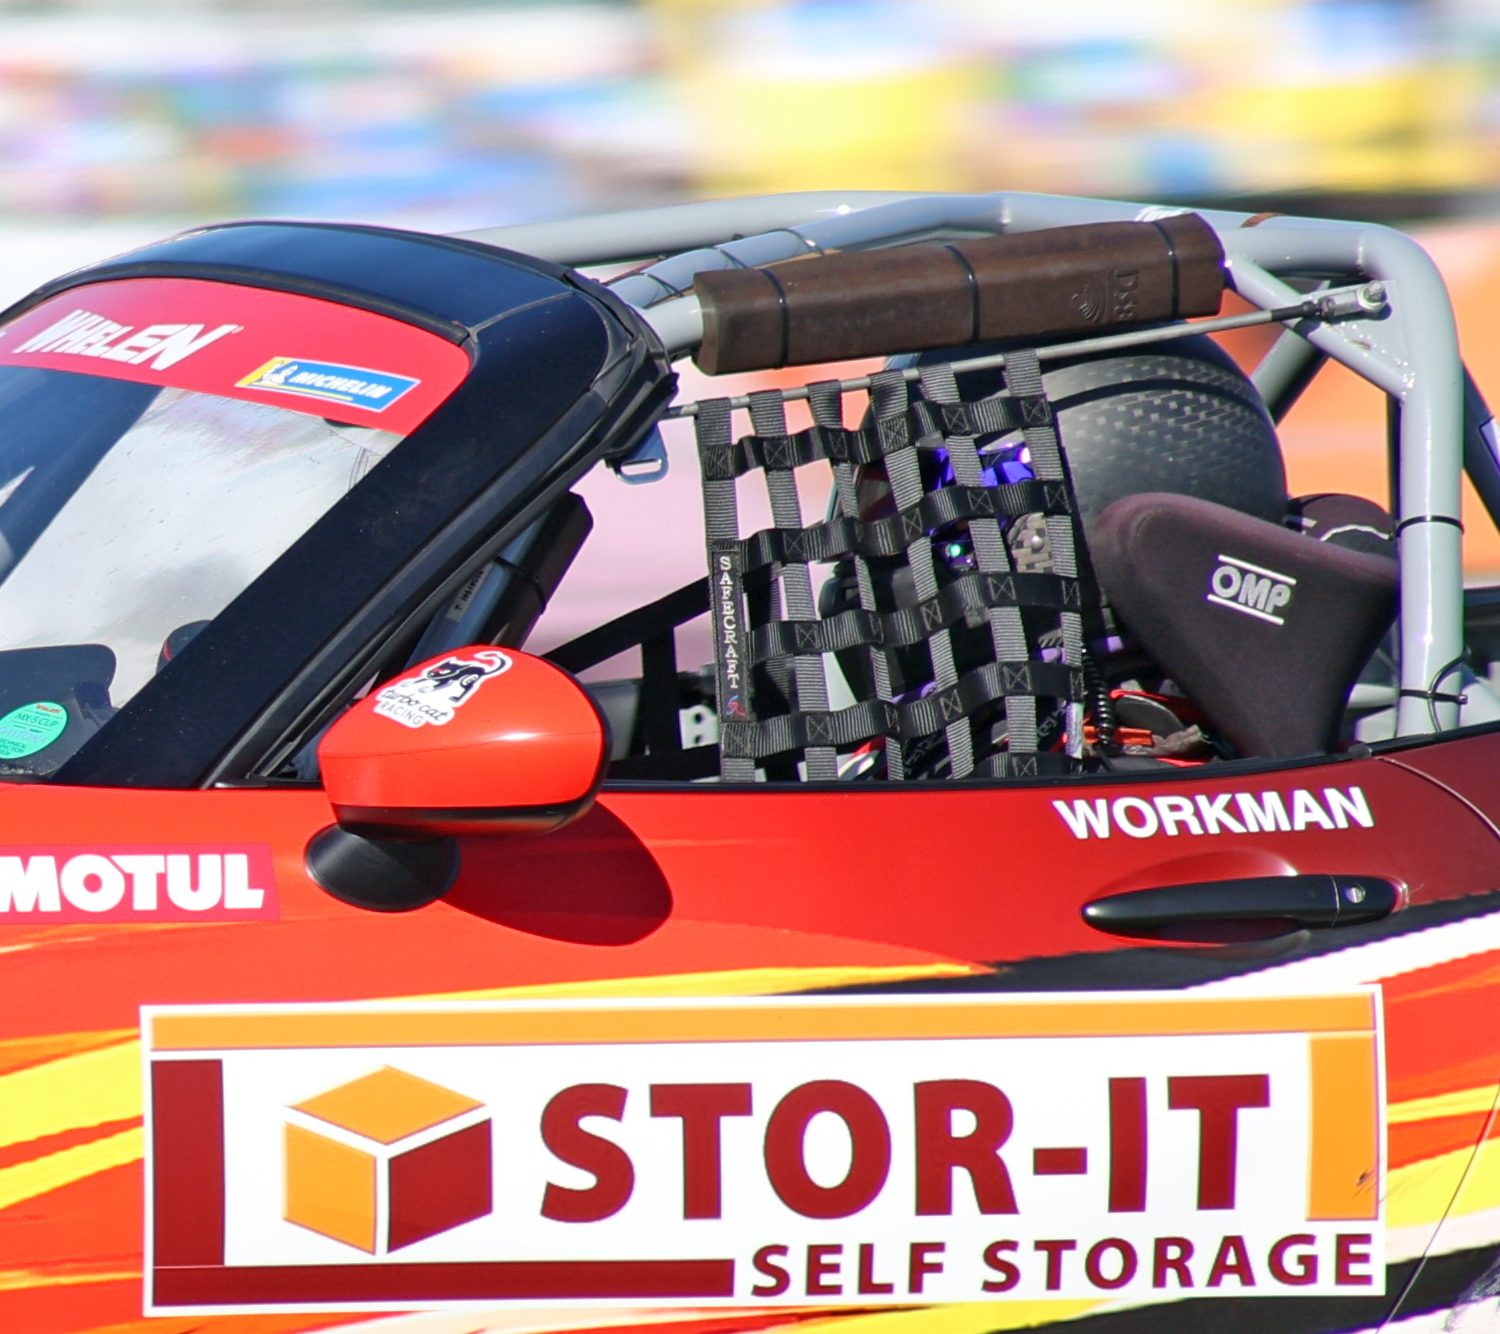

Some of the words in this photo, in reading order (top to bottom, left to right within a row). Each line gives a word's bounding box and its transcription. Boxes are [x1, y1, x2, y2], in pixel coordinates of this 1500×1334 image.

[12, 308, 238, 371] WHELEN
[287, 371, 393, 399] MICHELIN
[1212, 565, 1291, 614] OMP
[719, 555, 741, 689] SAFECRAFT
[38, 717, 60, 727] CUP
[379, 700, 424, 726] RACING
[381, 689, 420, 706] turbo
[418, 703, 449, 721] cat
[1053, 786, 1376, 842] WORKMAN
[539, 1073, 1272, 1224] STOR-IT
[750, 1241, 946, 1299] SELF
[981, 1232, 1375, 1294] STORAGE
